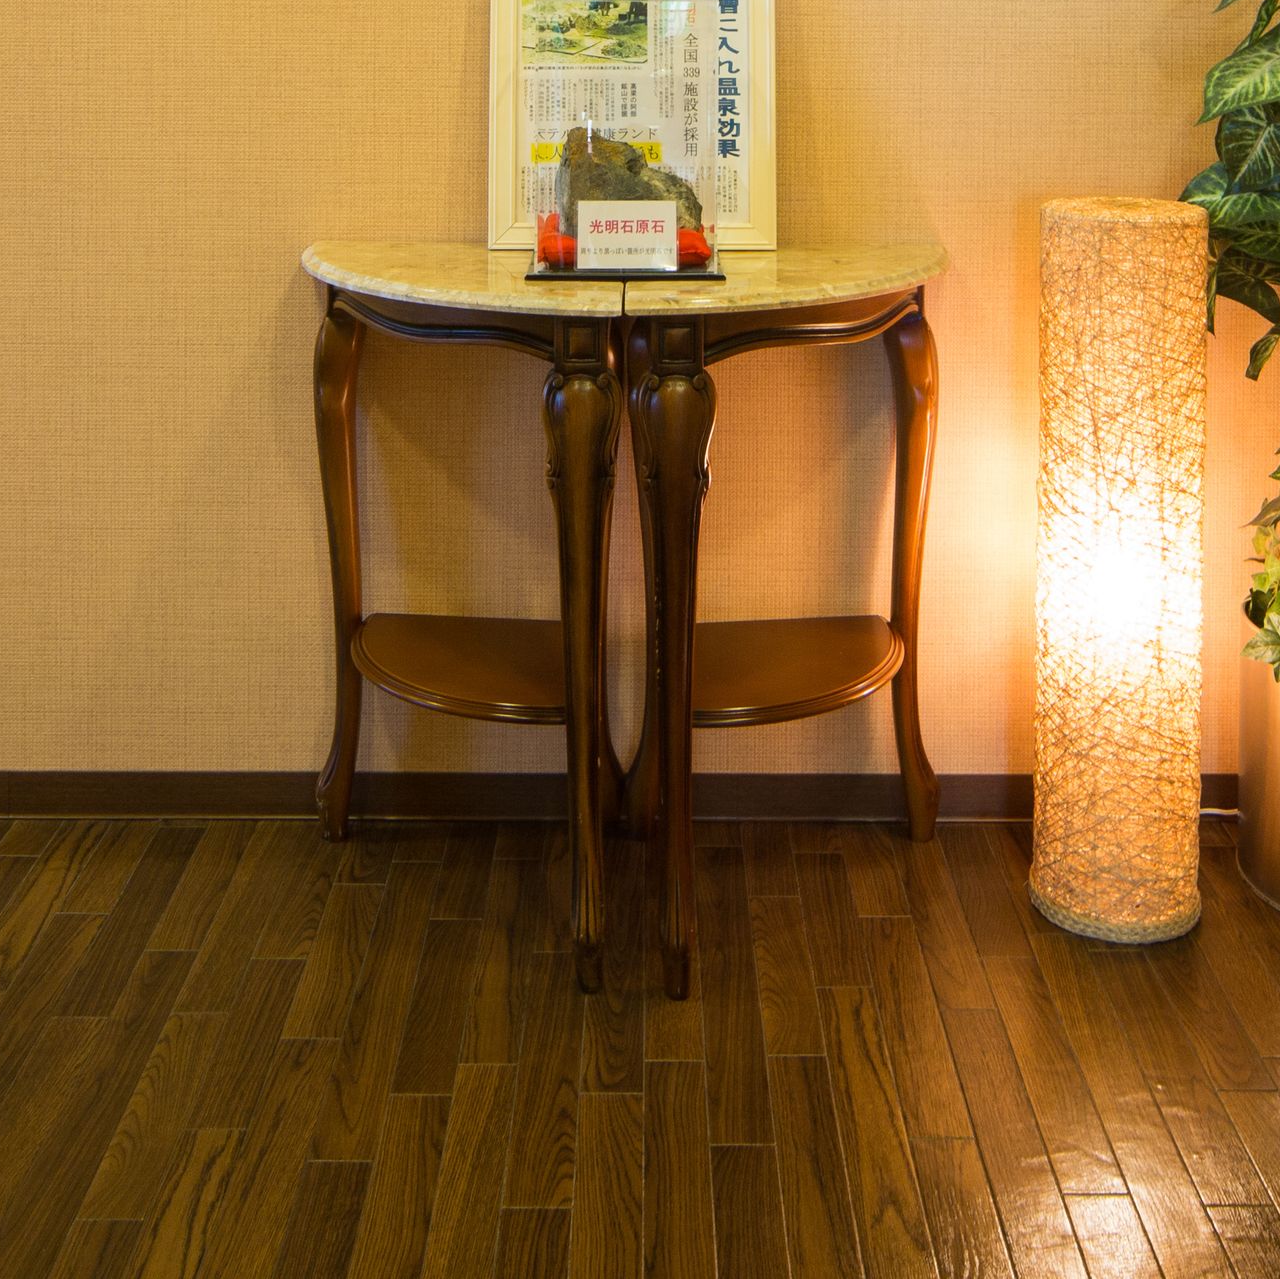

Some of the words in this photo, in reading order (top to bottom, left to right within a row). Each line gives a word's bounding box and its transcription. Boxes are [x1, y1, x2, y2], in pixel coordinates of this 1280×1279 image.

[589, 219, 666, 234] 光明石原石
